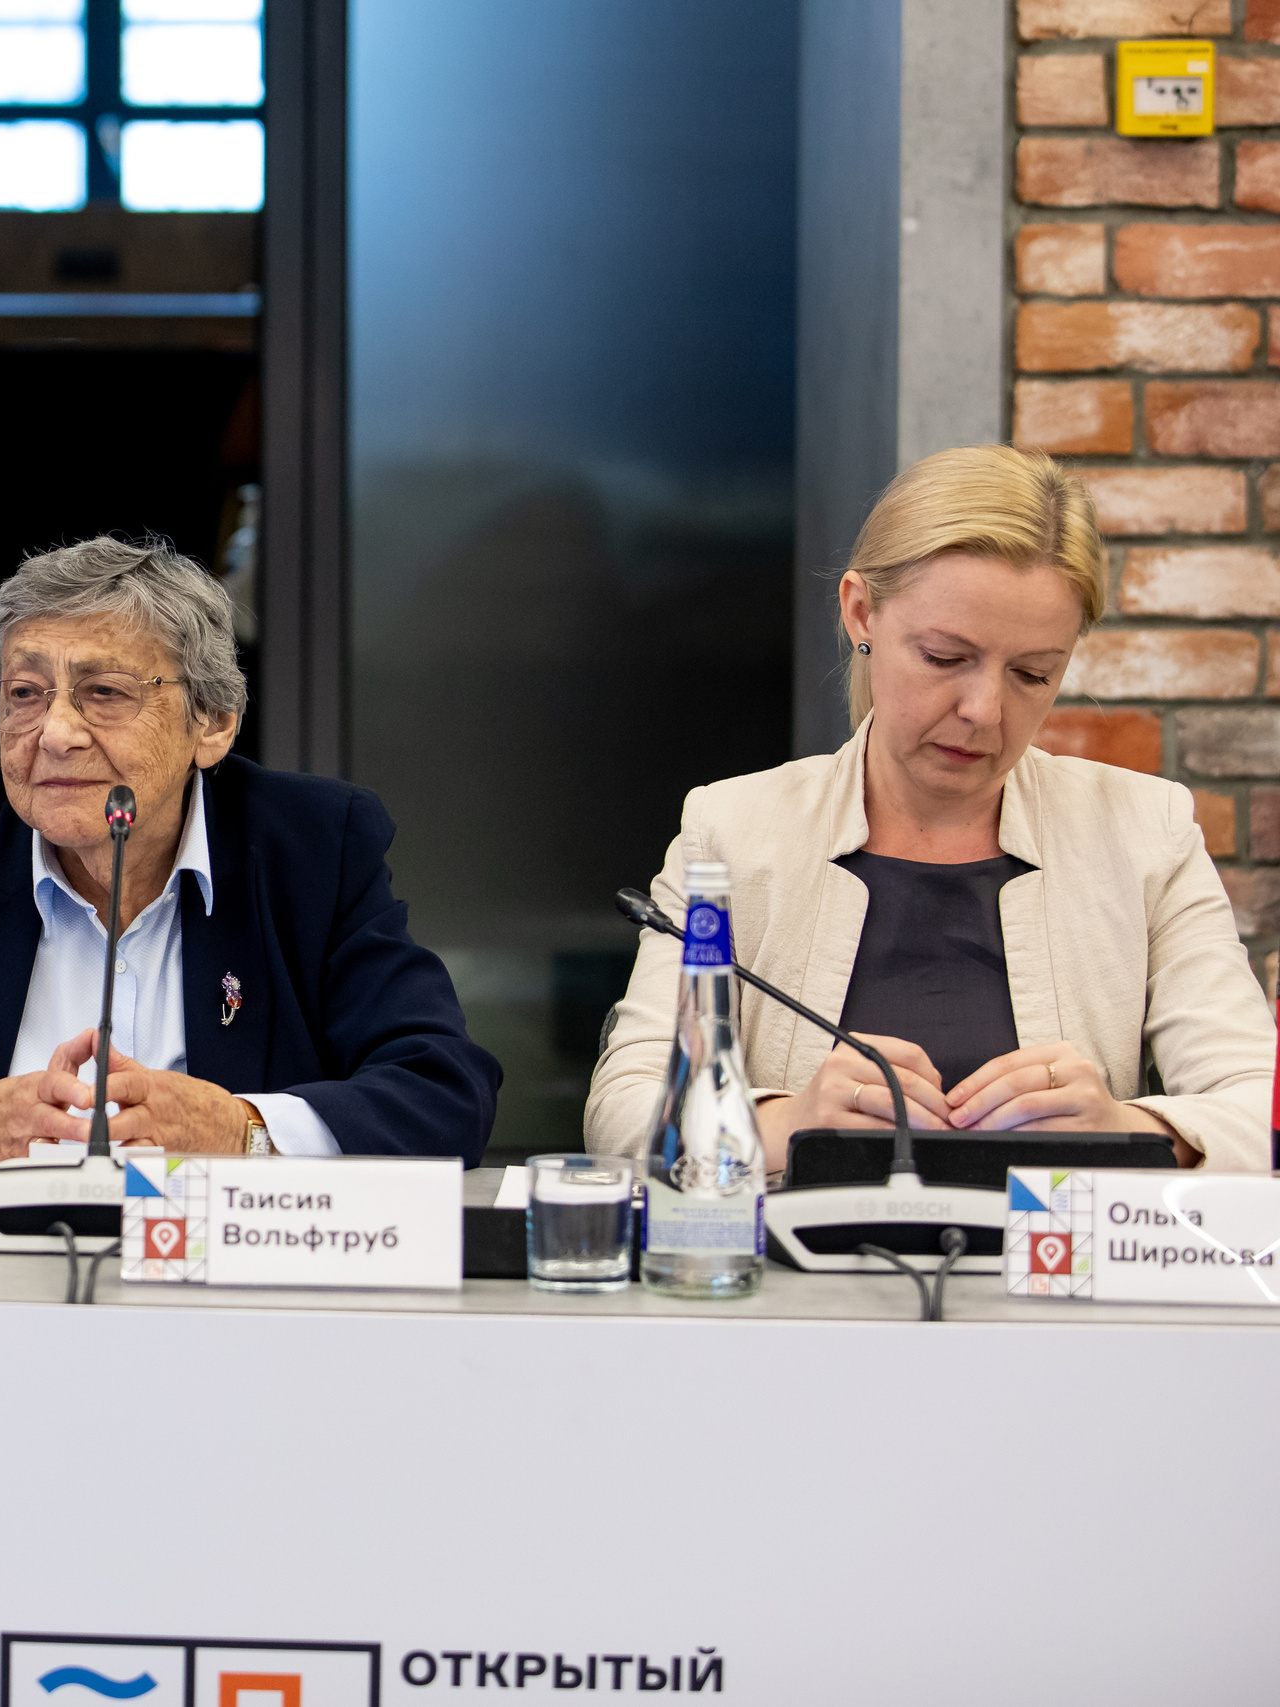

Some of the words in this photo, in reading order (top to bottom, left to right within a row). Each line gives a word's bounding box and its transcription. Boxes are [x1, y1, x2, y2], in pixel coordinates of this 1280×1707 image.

[222, 1187, 333, 1211] Таисия
[886, 1201, 952, 1217] BOSCH
[222, 1223, 400, 1252] Вольфтруб
[1108, 1238, 1274, 1269] Широкова
[400, 1646, 724, 1692] ОТКРЫТЫЙ
